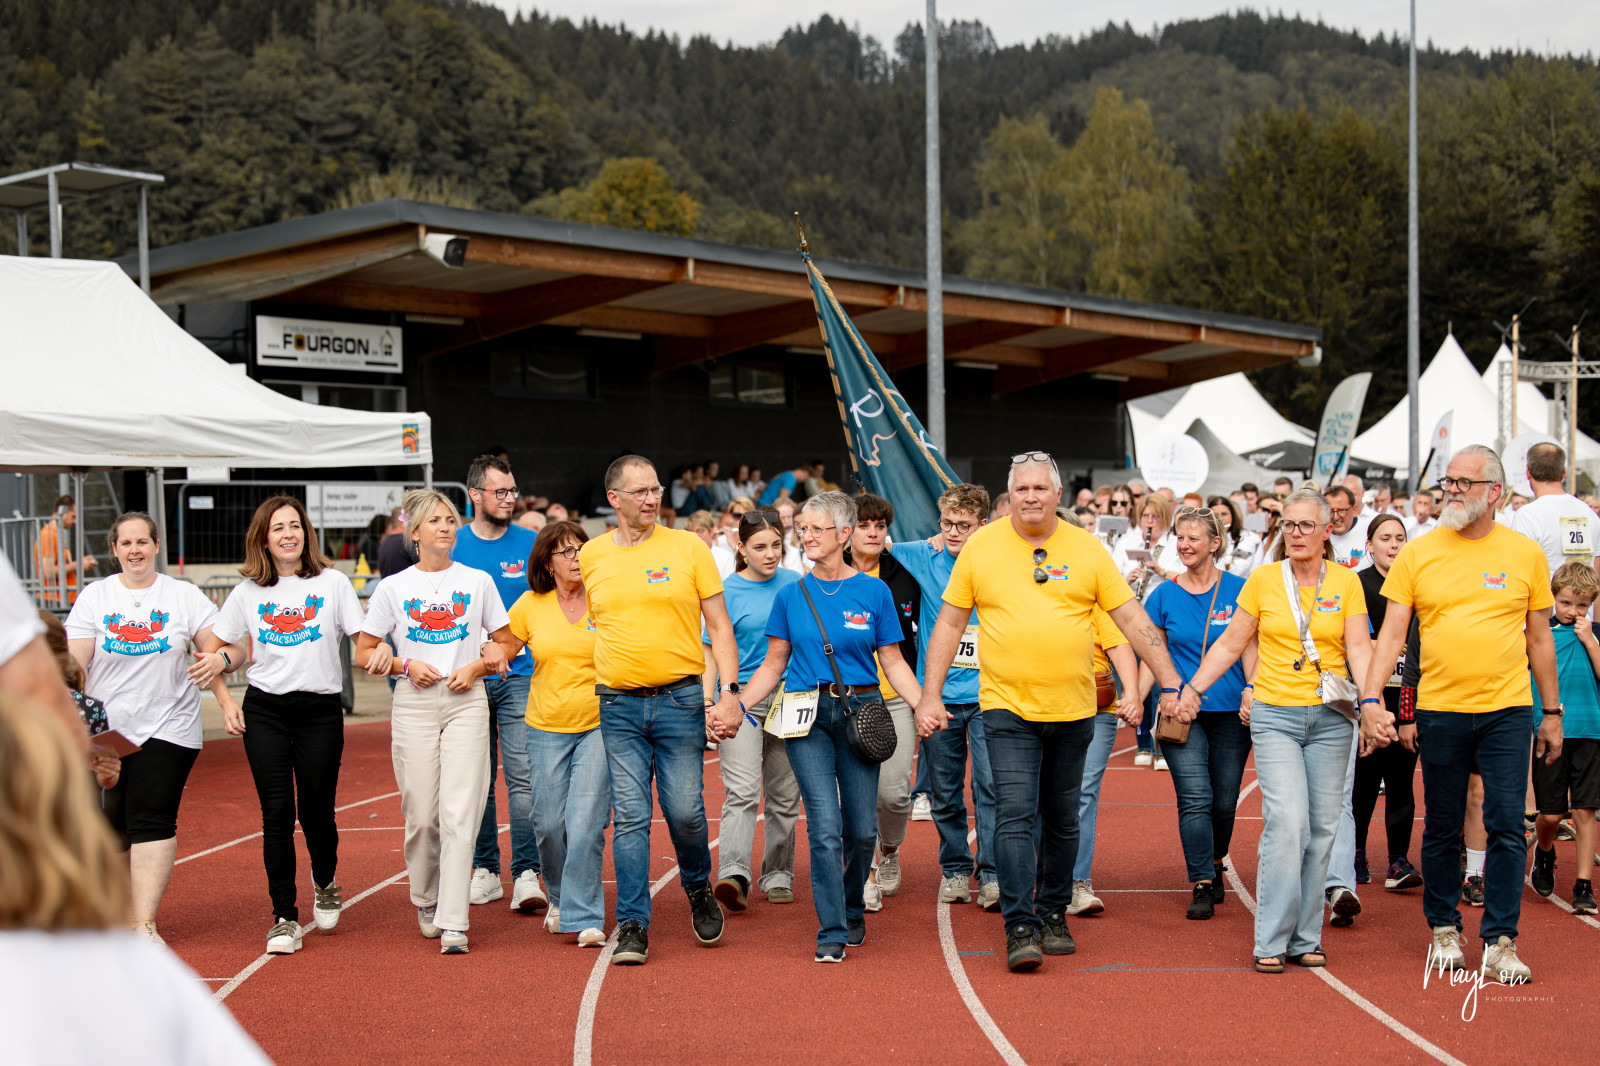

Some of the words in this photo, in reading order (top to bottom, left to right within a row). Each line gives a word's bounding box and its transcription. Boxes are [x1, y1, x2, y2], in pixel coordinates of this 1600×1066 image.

[283, 333, 369, 355] FOURGON
[265, 629, 312, 644] CRAC'SATHON
[415, 627, 462, 642] CRAC'SATHON
[110, 640, 160, 653] CRAC'SATHON
[797, 706, 814, 724] 771
